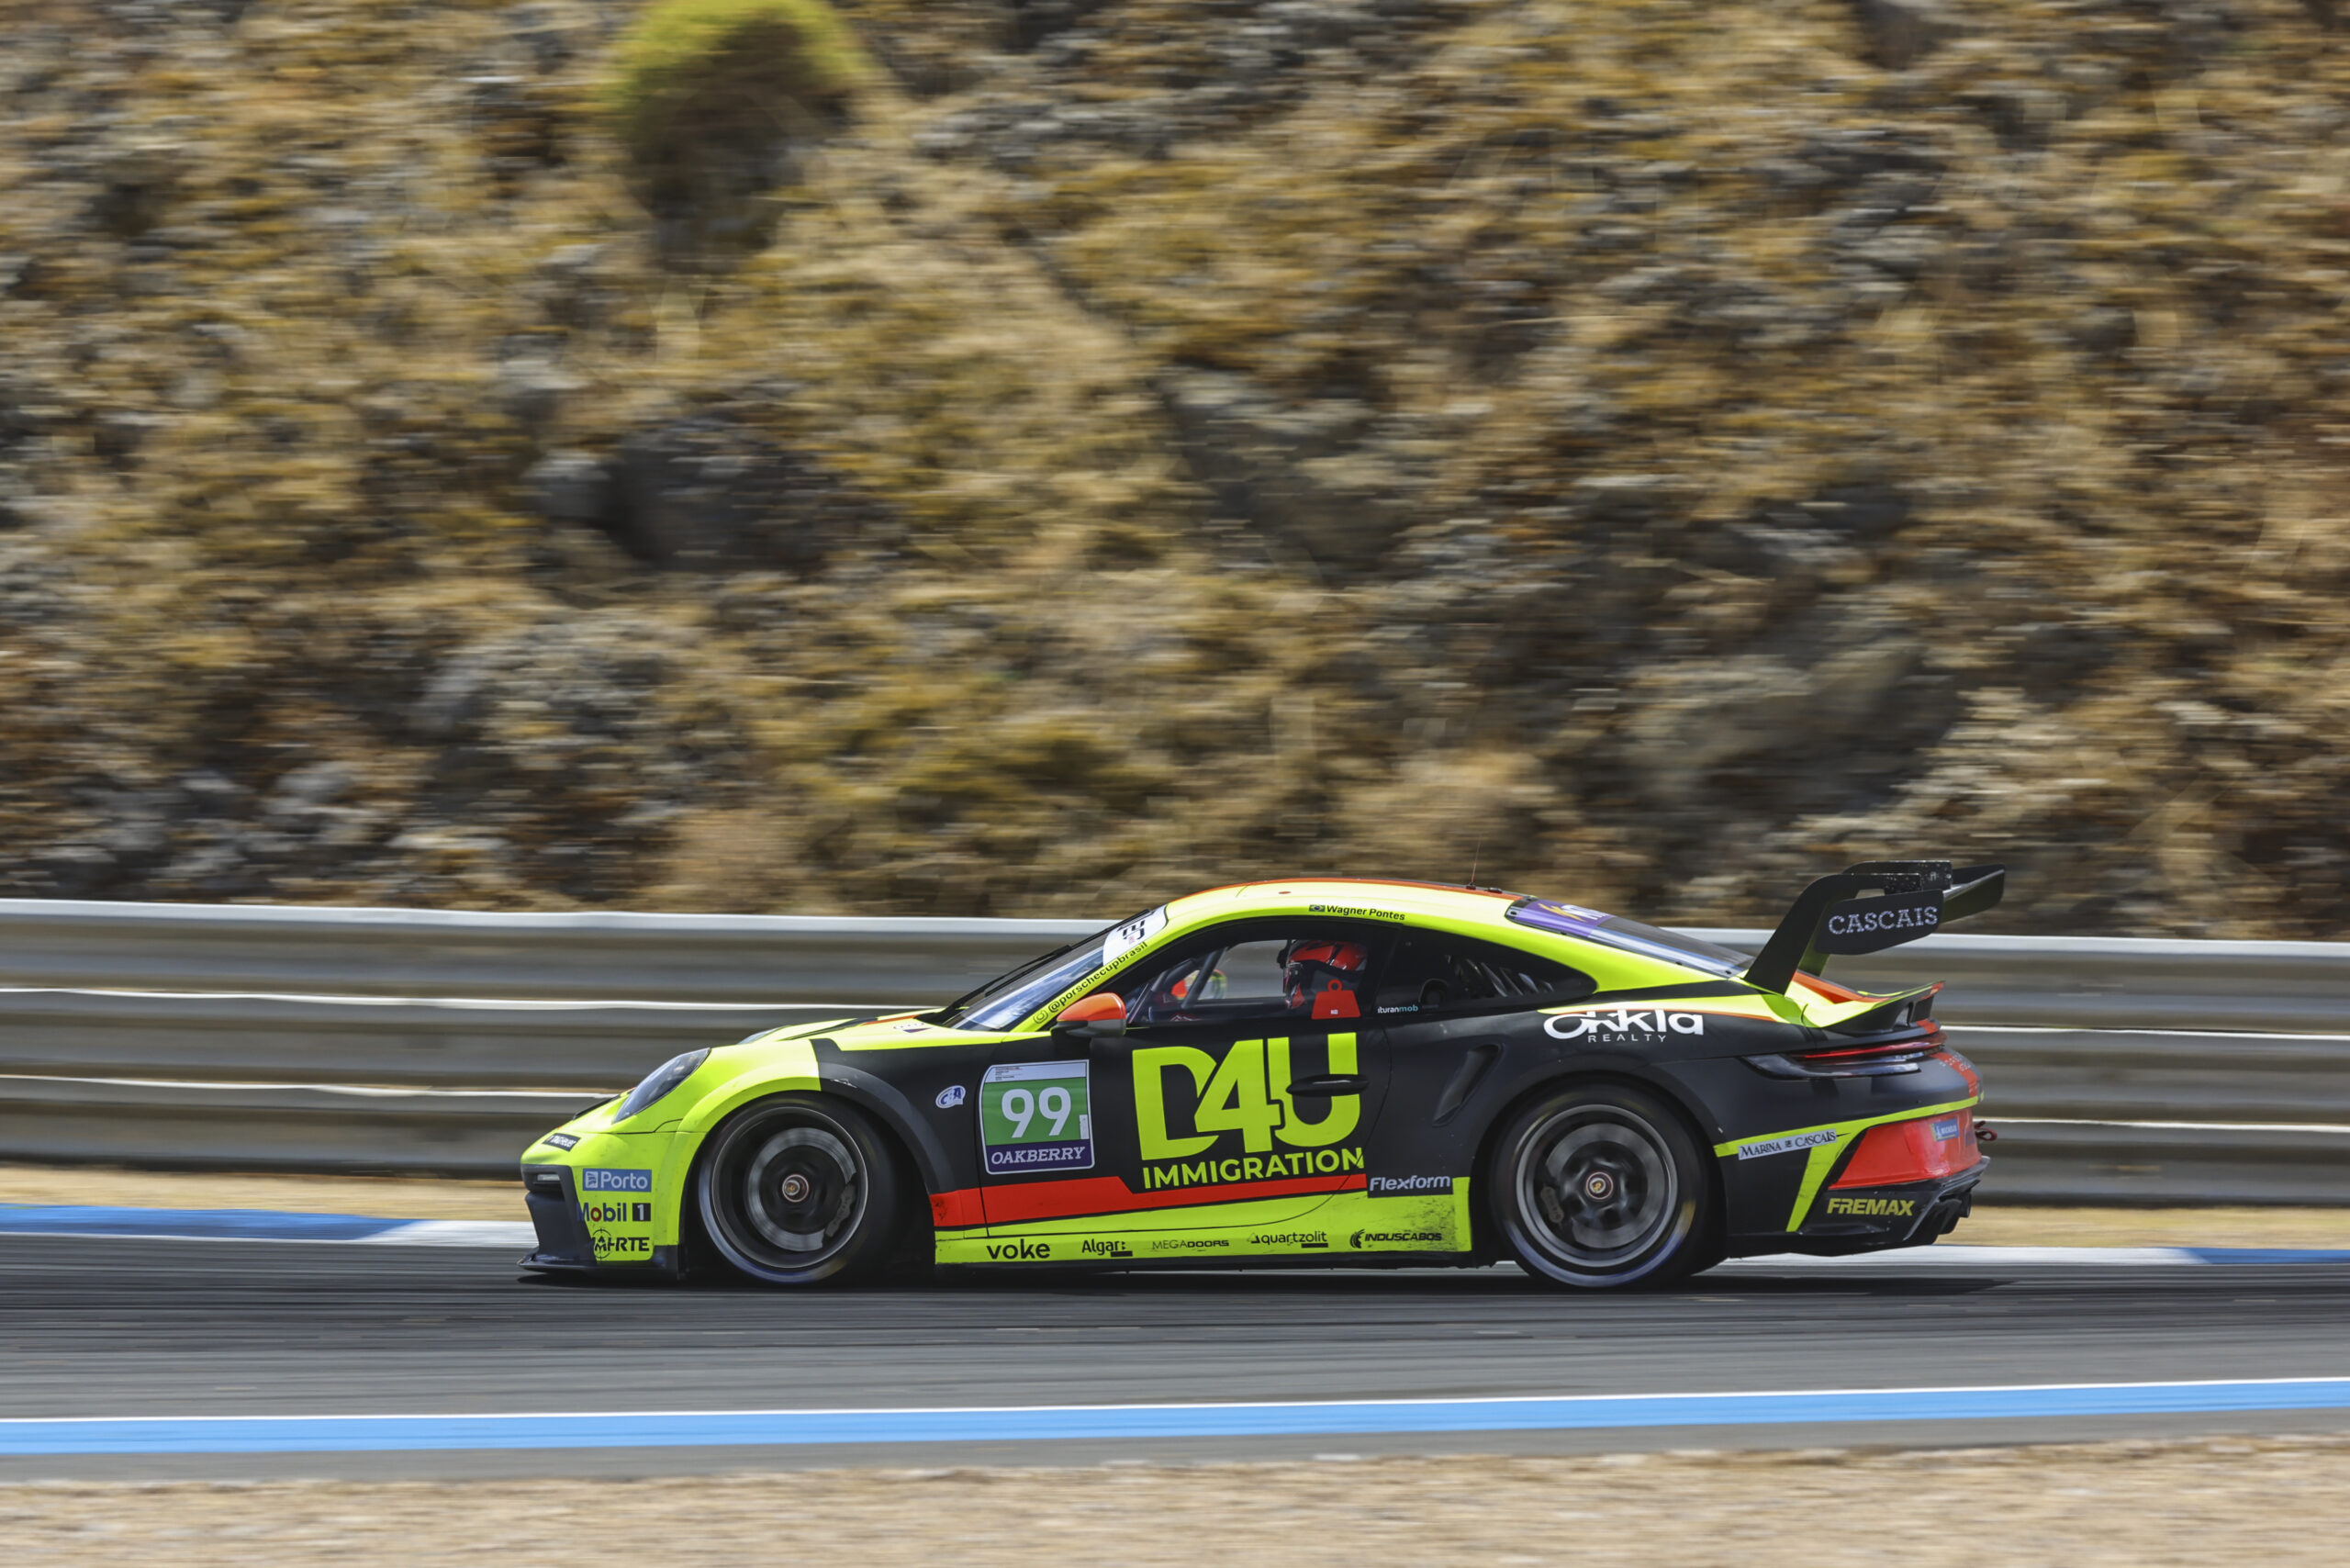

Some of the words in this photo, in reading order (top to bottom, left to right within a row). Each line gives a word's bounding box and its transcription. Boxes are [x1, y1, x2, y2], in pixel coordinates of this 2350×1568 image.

[1326, 905, 1367, 916] Wagner
[1369, 908, 1405, 921] Pontes
[1829, 906, 1938, 935] CASCAIS
[1048, 941, 1147, 1014] @porschecupbrasil
[1588, 1034, 1666, 1043] REALTY
[1132, 1032, 1361, 1160] D4U
[1002, 1087, 1071, 1138] 99
[1740, 1142, 1782, 1157] MARINA
[1795, 1131, 1836, 1147] CASCAIS
[991, 1147, 1085, 1164] OAKBERRY
[1142, 1148, 1365, 1189] IMMIGRATION
[600, 1170, 648, 1189] Porto
[1370, 1175, 1450, 1192] Flexform
[576, 1202, 627, 1222] Mobil
[1827, 1198, 1916, 1216] FREMAX
[1152, 1240, 1229, 1250] MEGADOORS
[1261, 1231, 1327, 1245] quartzolit
[1365, 1233, 1442, 1242] INDUSCABOS
[987, 1238, 1050, 1260] voke
